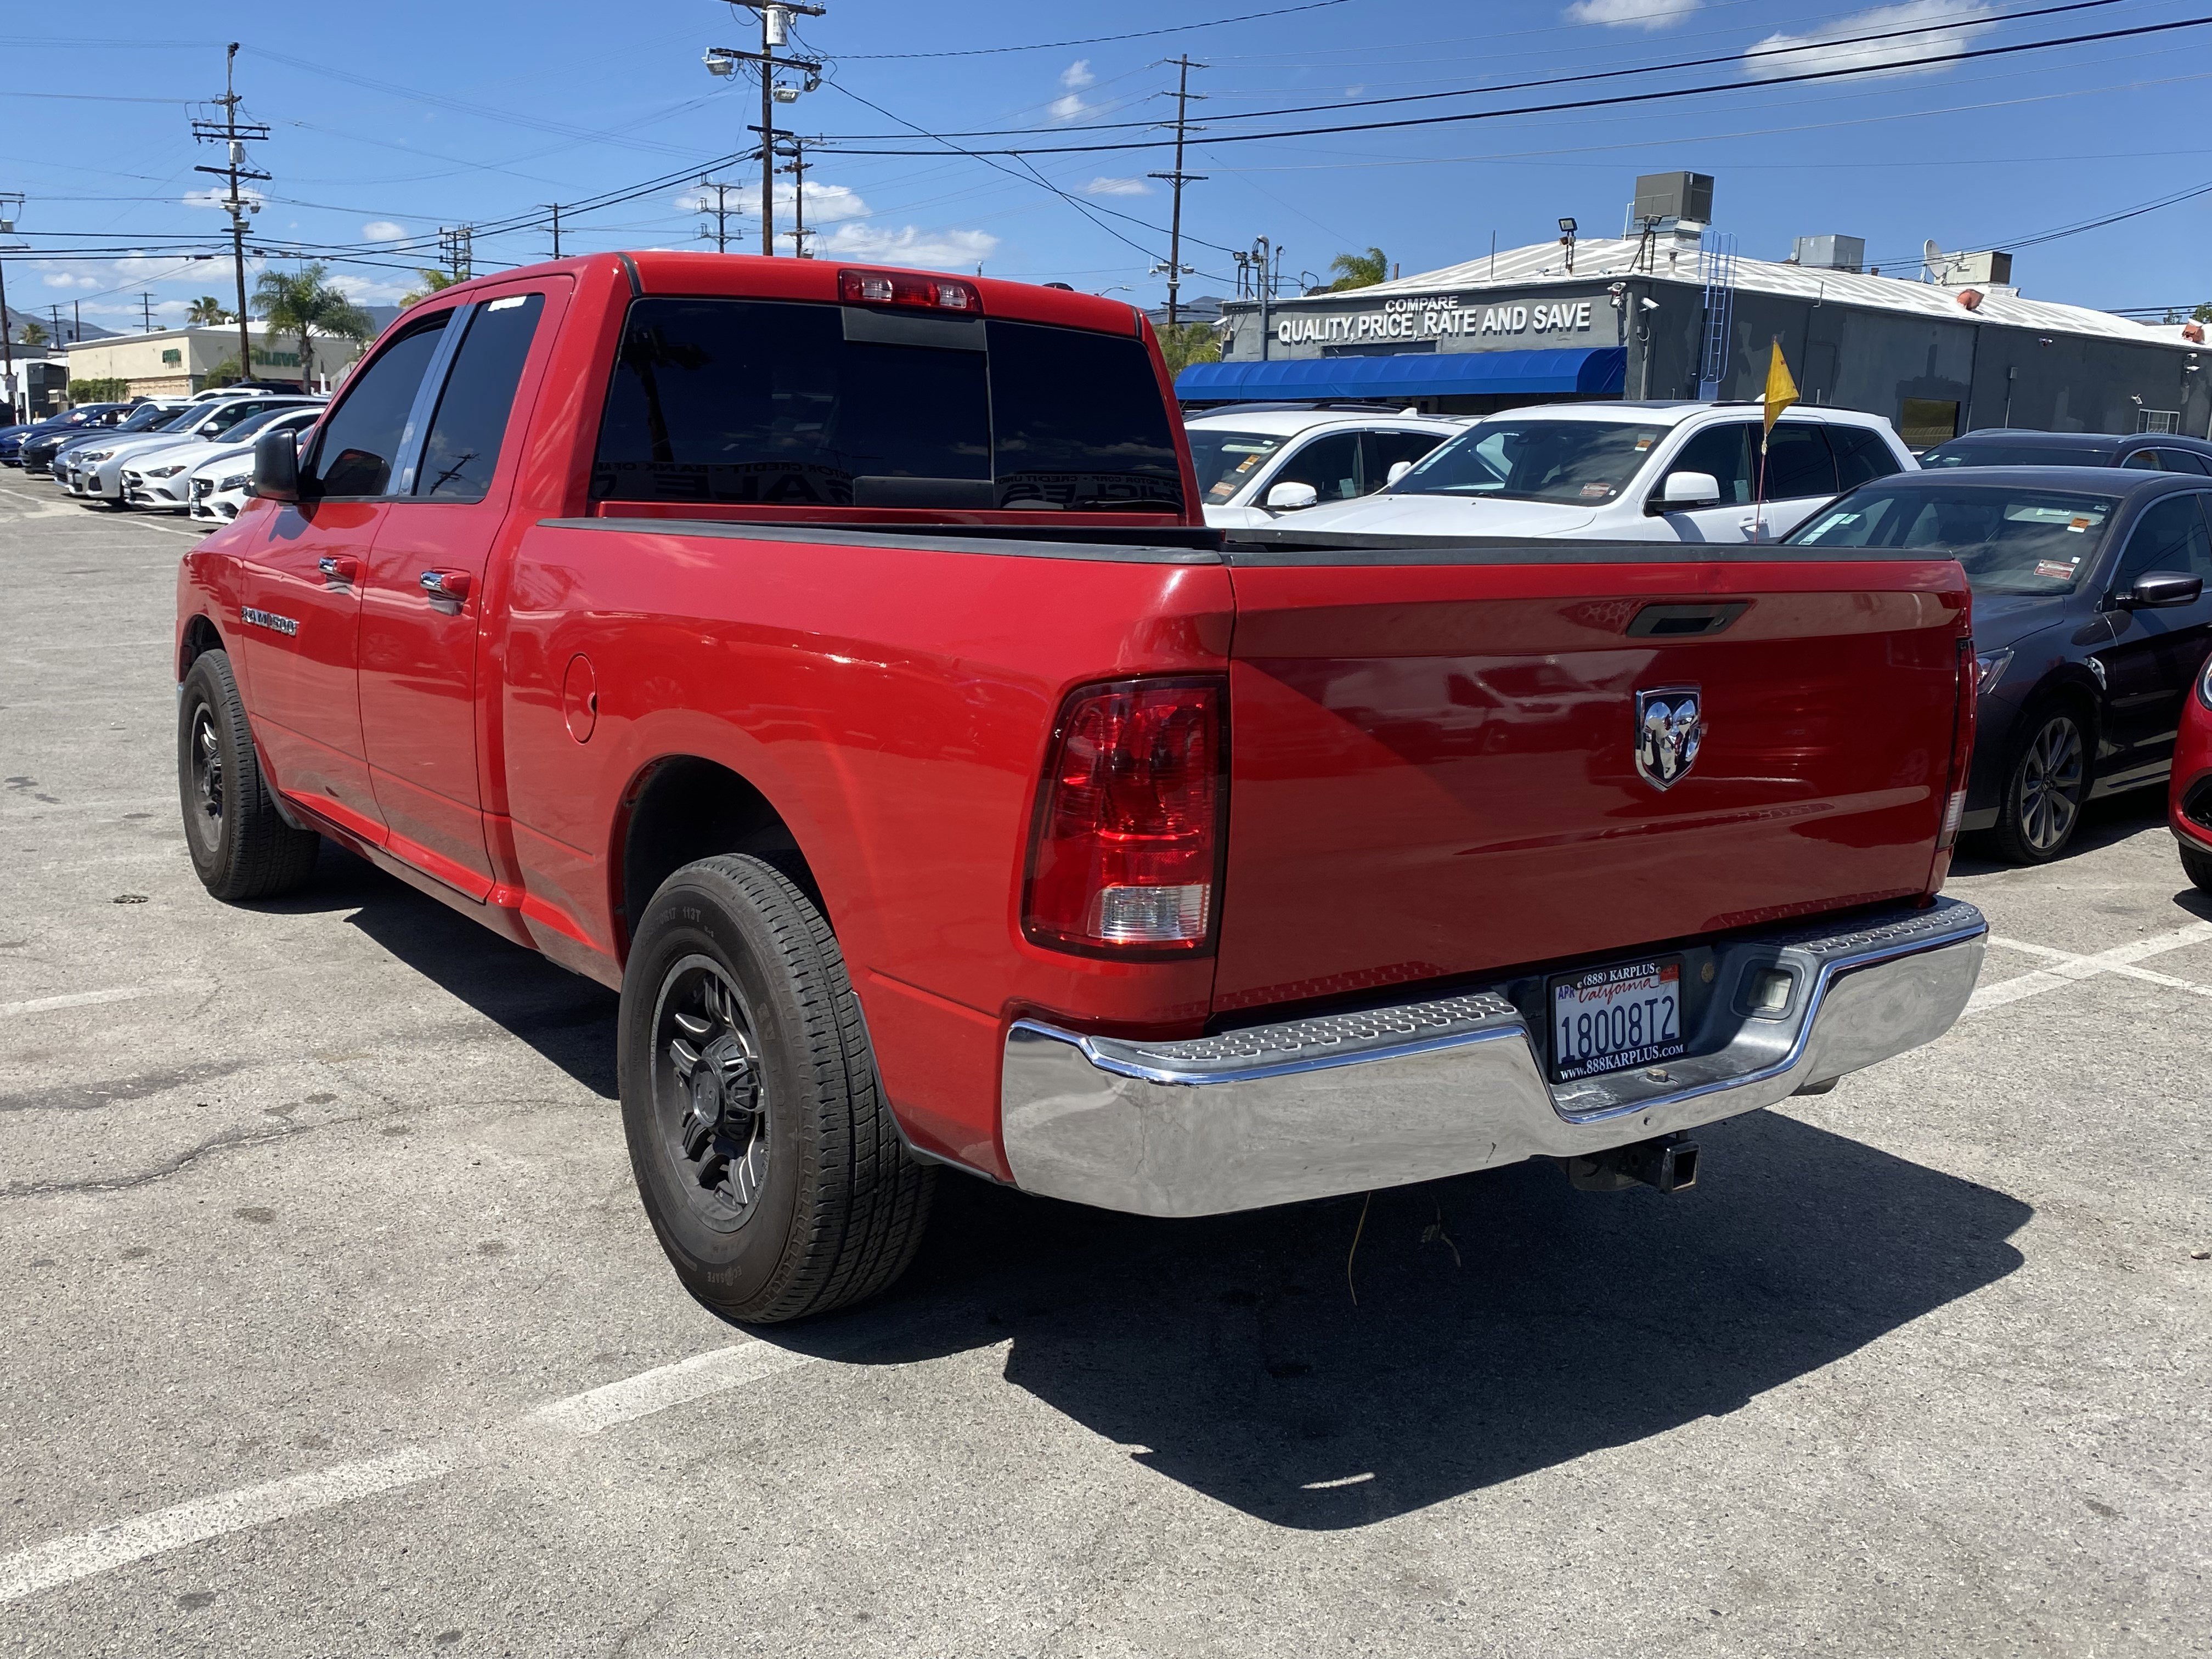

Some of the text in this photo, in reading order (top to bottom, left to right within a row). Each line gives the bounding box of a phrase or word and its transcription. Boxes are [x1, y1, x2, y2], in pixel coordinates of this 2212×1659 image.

[1385, 296, 1459, 314] COMPARE
[1278, 302, 1591, 343] QUALITY, PRICE, RATE AND SAVE
[1583, 972, 1607, 986] (888)
[1610, 963, 1655, 981] KARPLUS
[1578, 977, 1660, 1005] California
[1561, 995, 1675, 1063] 18008T2
